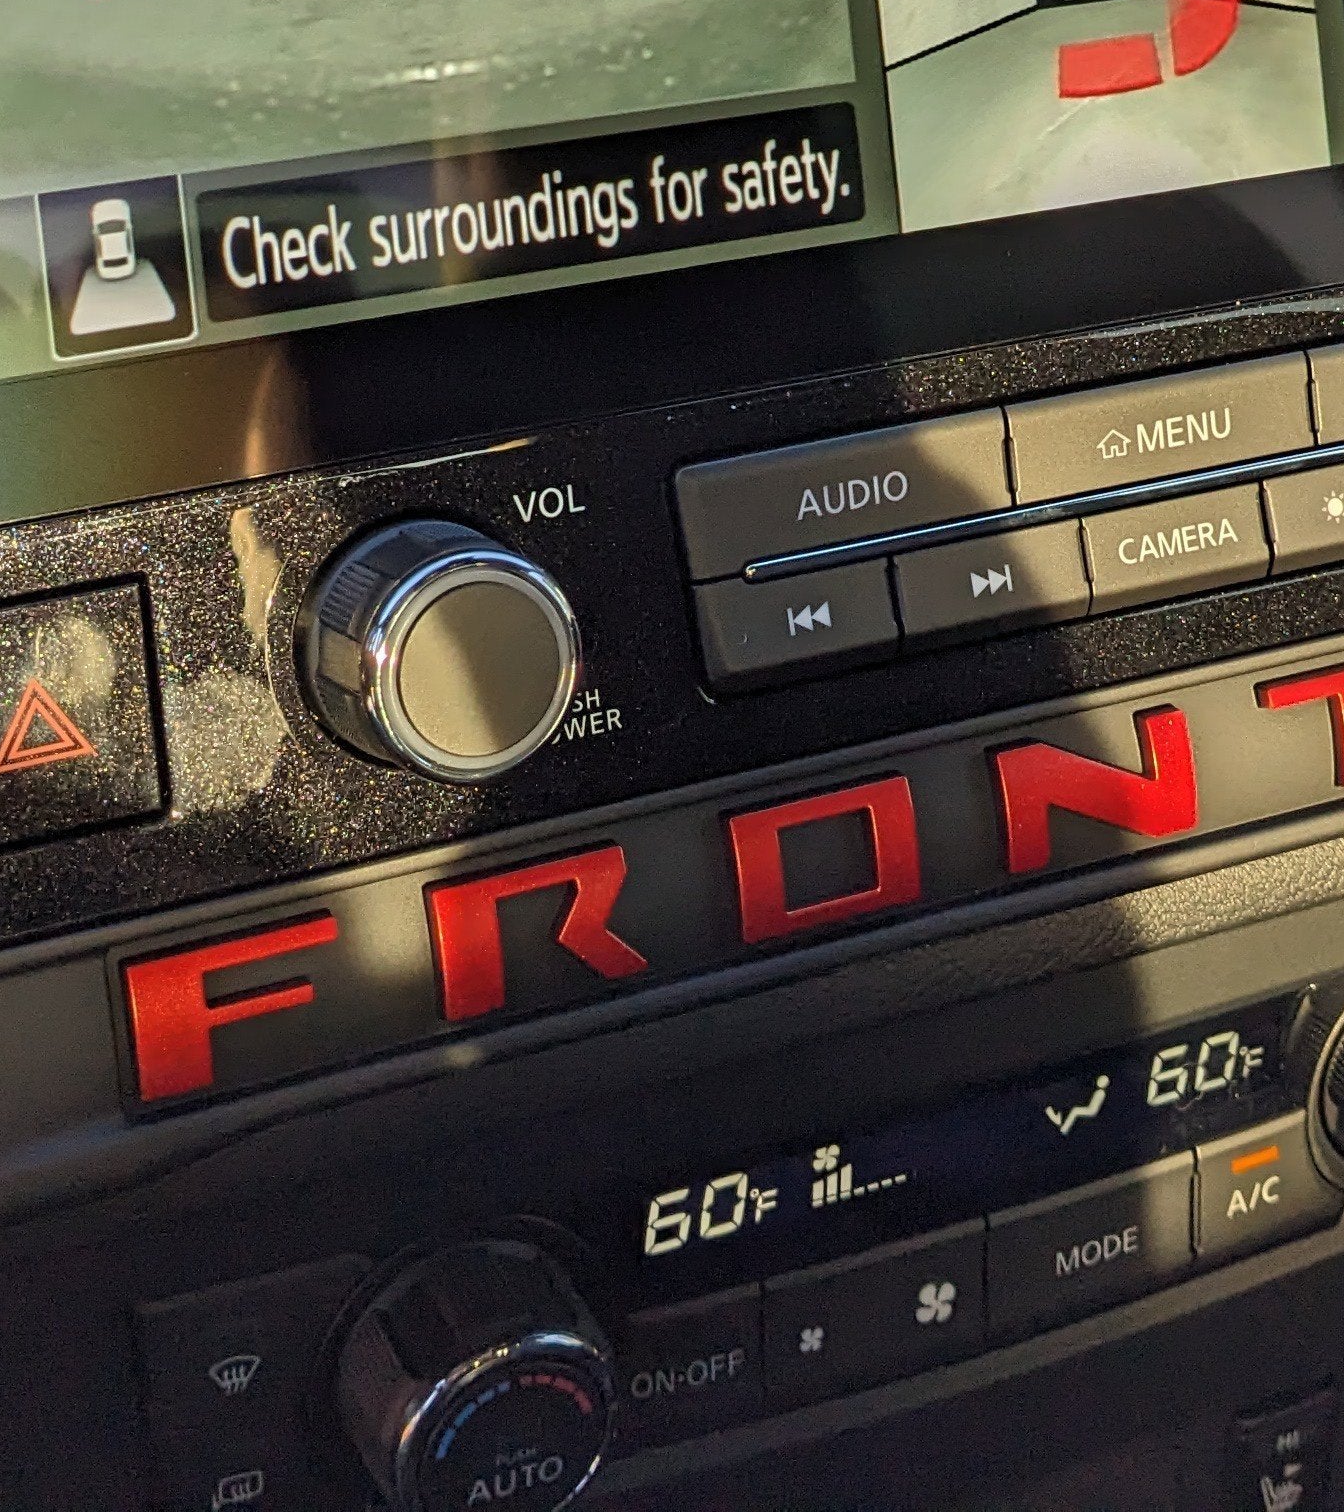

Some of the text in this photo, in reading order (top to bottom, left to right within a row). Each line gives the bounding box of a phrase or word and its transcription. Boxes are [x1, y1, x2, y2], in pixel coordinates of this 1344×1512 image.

[221, 138, 850, 289] Check surroundings for safety.
[1136, 407, 1232, 454] MENU
[513, 483, 586, 523] VOL
[795, 470, 909, 521] AUDIO
[1118, 517, 1238, 565] CAMERA
[1226, 1175, 1280, 1219] A/C
[1056, 1225, 1138, 1276] MODE
[467, 1456, 563, 1506] AUTO
